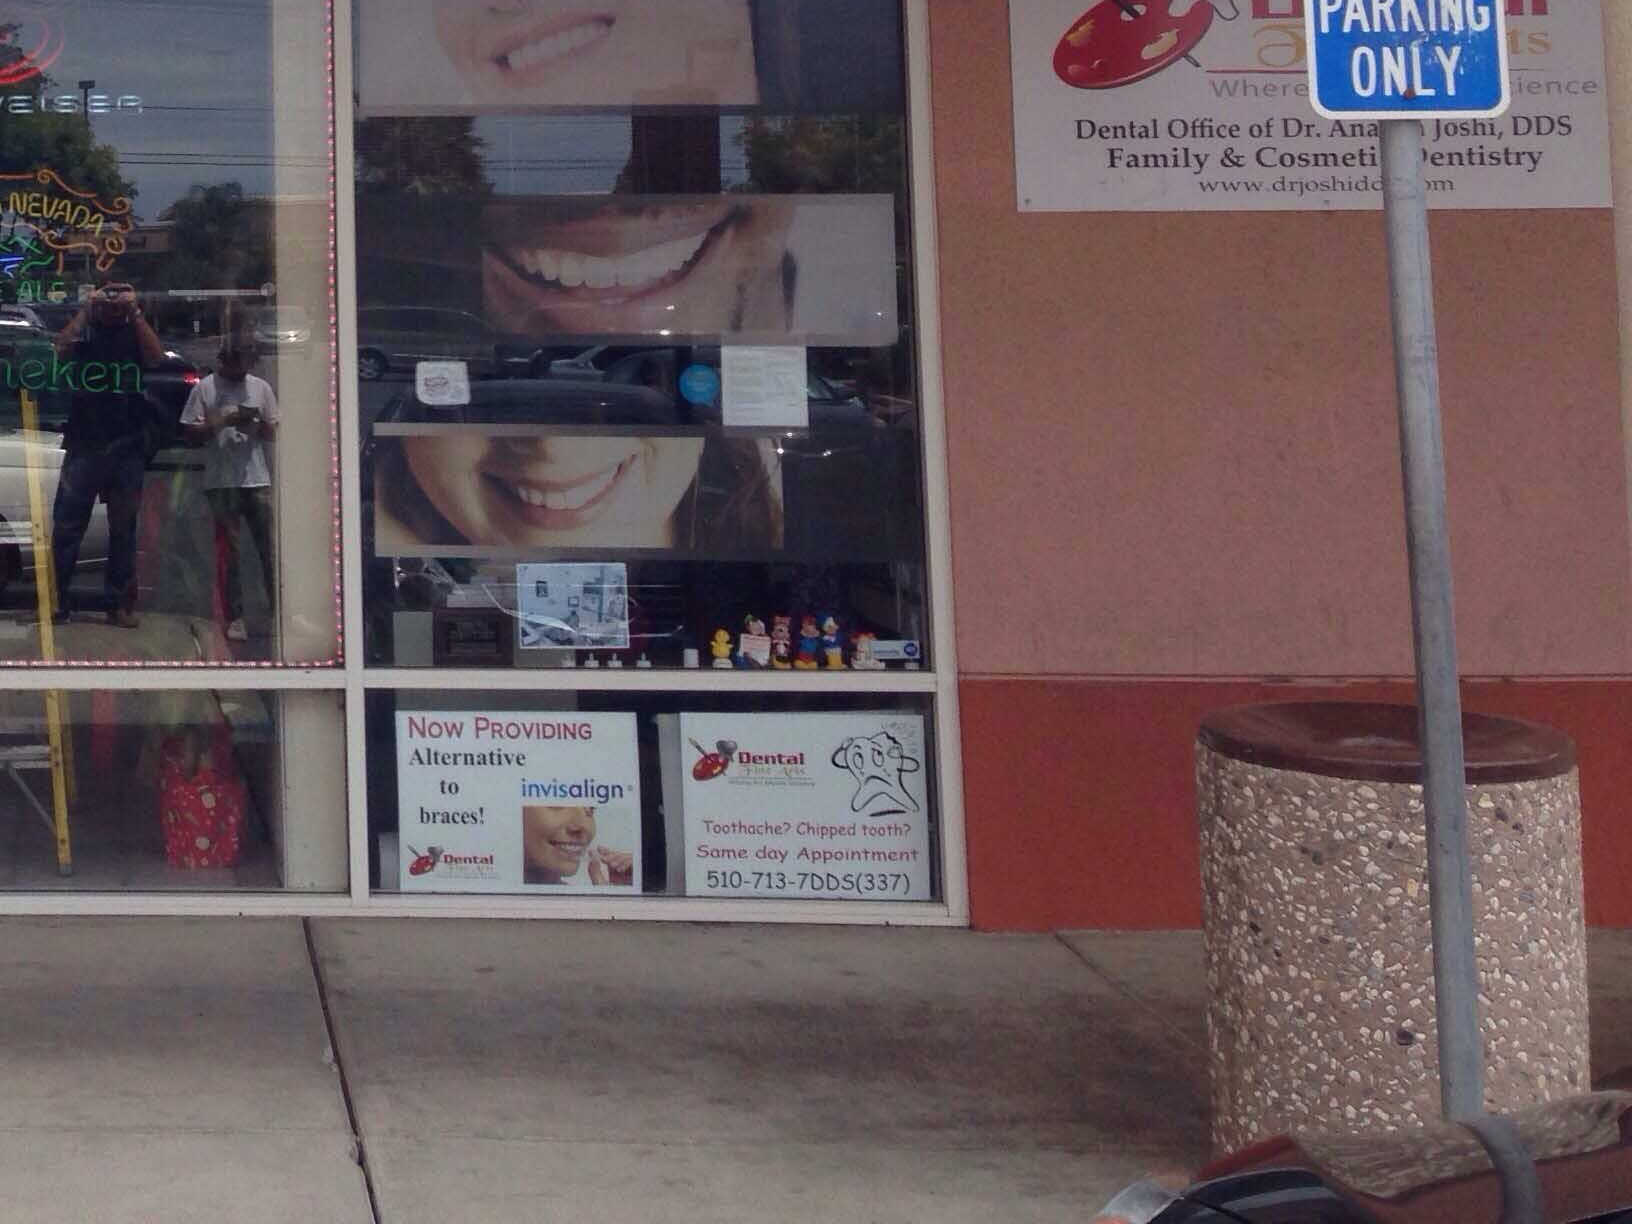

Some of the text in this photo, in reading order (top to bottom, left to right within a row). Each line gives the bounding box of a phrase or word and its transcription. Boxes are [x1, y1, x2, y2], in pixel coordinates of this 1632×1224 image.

[1351, 45, 1462, 97] ONLY
[1210, 79, 1309, 97] Where
[1075, 118, 1159, 140] Dental
[1168, 118, 1245, 139] Office
[1250, 118, 1274, 137] of
[1282, 119, 1321, 138] Dr.
[1432, 116, 1504, 142] Joshi,
[1512, 114, 1572, 137] DDS
[1107, 144, 1543, 175] Family & Cosmeti entistry
[8, 192, 105, 237] NEVADA
[17, 280, 66, 303] ALE
[409, 747, 526, 766] Alternative
[739, 751, 805, 765] Dental
[440, 779, 459, 795] to
[522, 779, 624, 804] invisalign
[420, 806, 484, 825] braces!
[703, 820, 911, 839] Toothache? Chipped tooth?
[443, 854, 494, 865] Dental
[696, 844, 918, 863] Same day Appointment
[707, 870, 911, 895] 510-713-7DDS(337)
